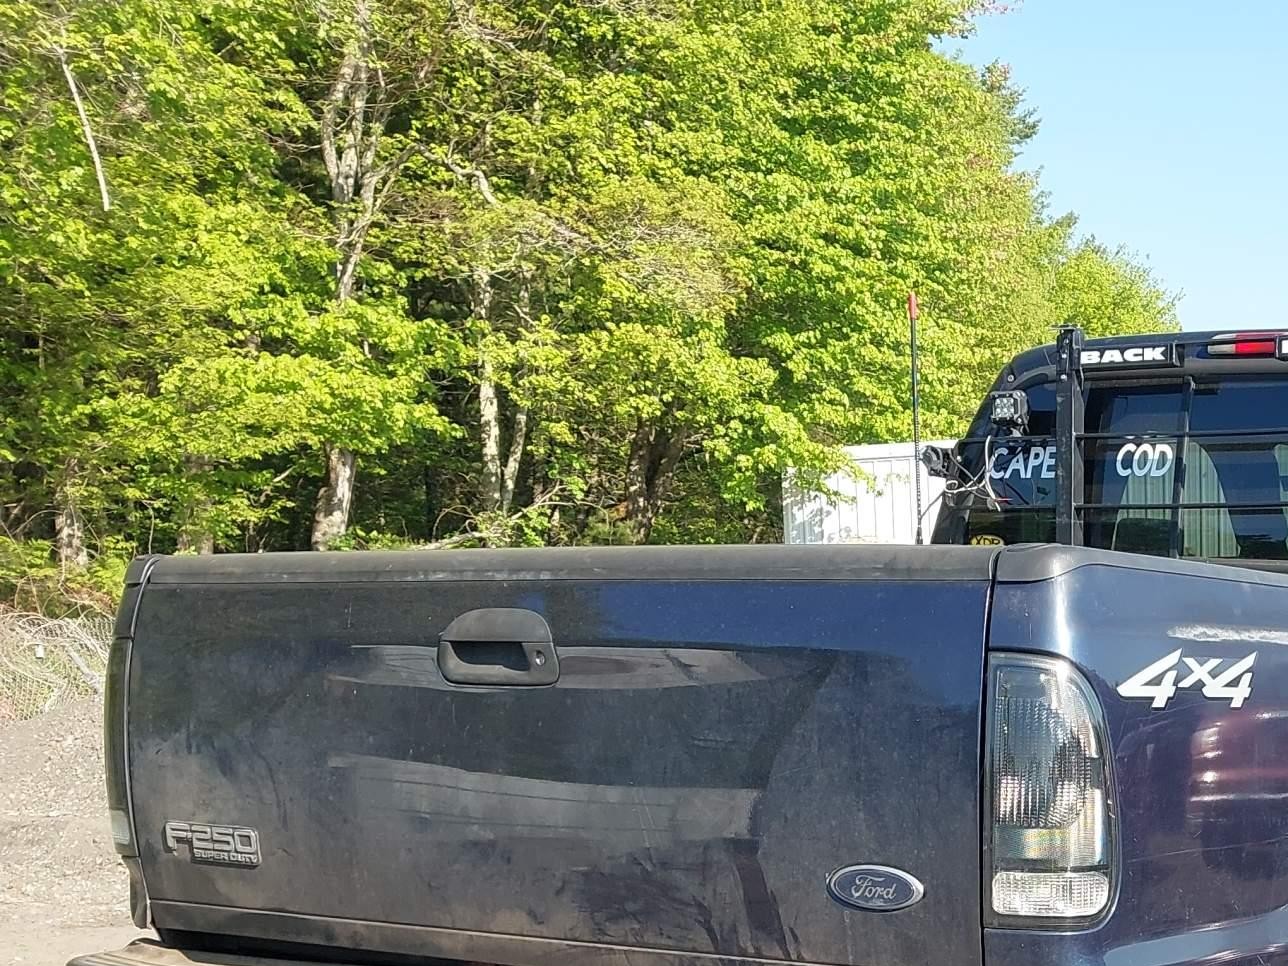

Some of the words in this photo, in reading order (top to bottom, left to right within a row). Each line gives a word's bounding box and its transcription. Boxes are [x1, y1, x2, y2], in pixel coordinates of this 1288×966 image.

[1080, 346, 1166, 364] BACK
[990, 446, 1056, 479] CAPE
[1115, 443, 1174, 477] COD
[193, 848, 228, 861] SUPER
[229, 852, 257, 863] DUTY
[851, 874, 897, 899] Ford
